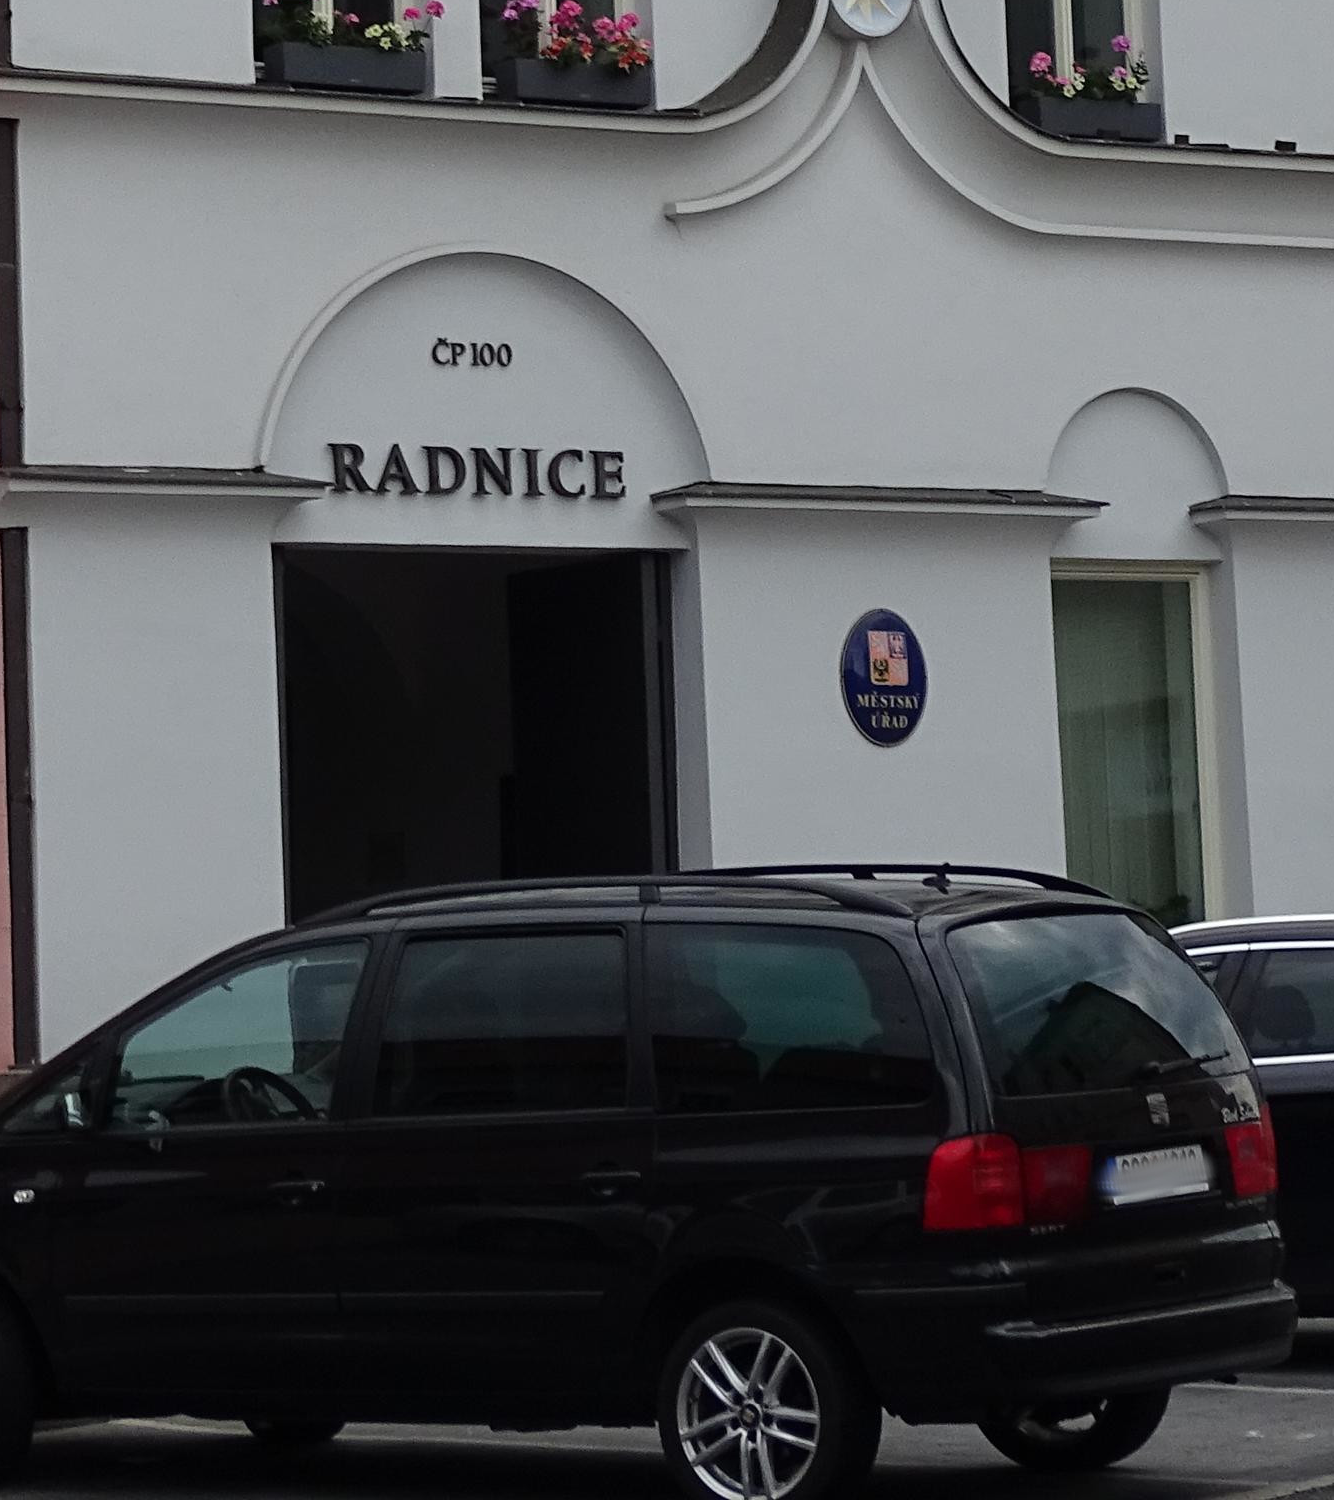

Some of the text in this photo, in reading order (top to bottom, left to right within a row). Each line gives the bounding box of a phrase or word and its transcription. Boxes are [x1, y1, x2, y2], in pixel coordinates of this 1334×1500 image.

[432, 337, 512, 367] ČP 100
[328, 443, 626, 498] RADNICE
[857, 691, 920, 709] MĚSTSKÝ
[871, 709, 908, 729] ÚŘAD
